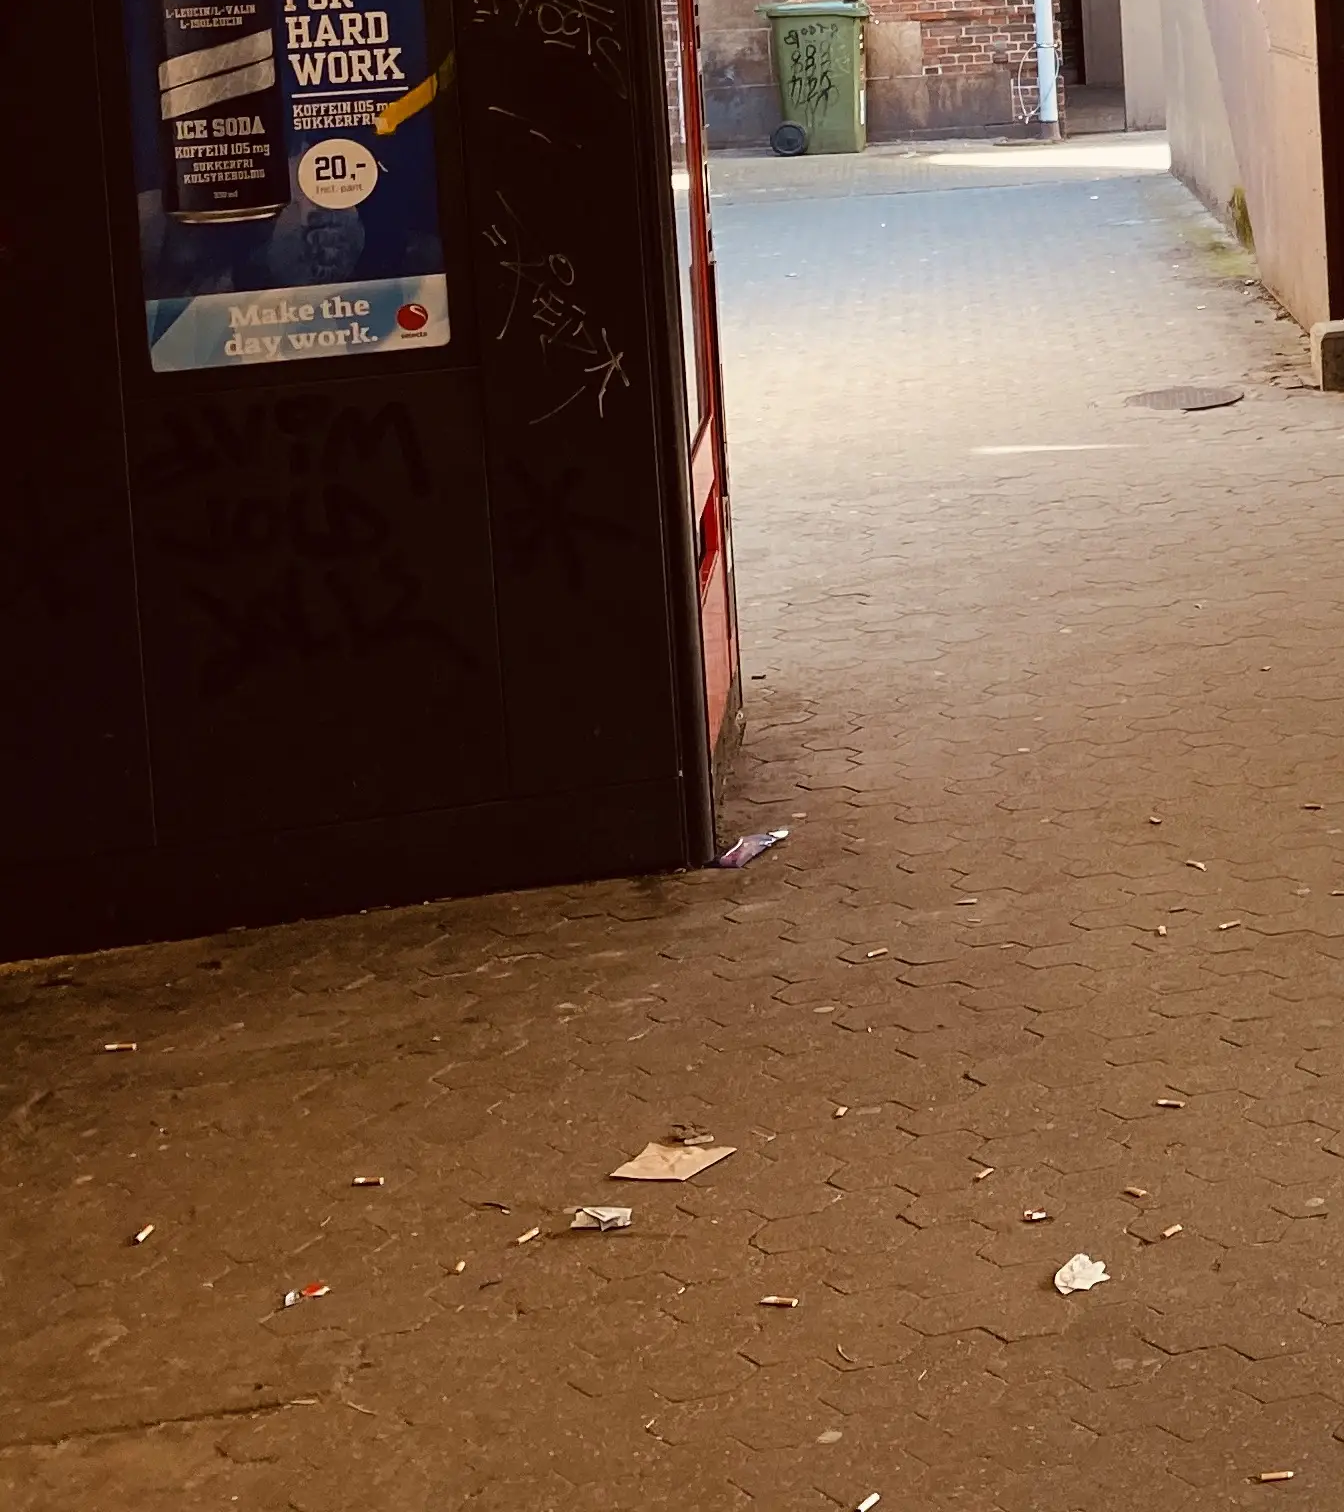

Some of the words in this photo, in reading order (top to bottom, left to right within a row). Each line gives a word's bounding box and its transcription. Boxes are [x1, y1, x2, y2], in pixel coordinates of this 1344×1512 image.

[285, 11, 388, 50] HARD
[288, 48, 405, 86] WORK
[293, 102, 351, 117] KOFFEIN
[354, 100, 375, 113] 105
[175, 120, 208, 140] ICE
[212, 116, 265, 137] SODA
[175, 144, 228, 159] KOFFEIN
[231, 143, 251, 155] 105
[252, 144, 270, 156] mg
[193, 159, 254, 172] SUKKERFRI
[315, 155, 366, 181] 20,-
[229, 299, 314, 328] Make
[320, 295, 370, 320] the
[224, 331, 283, 361] day
[287, 323, 378, 349] work.
